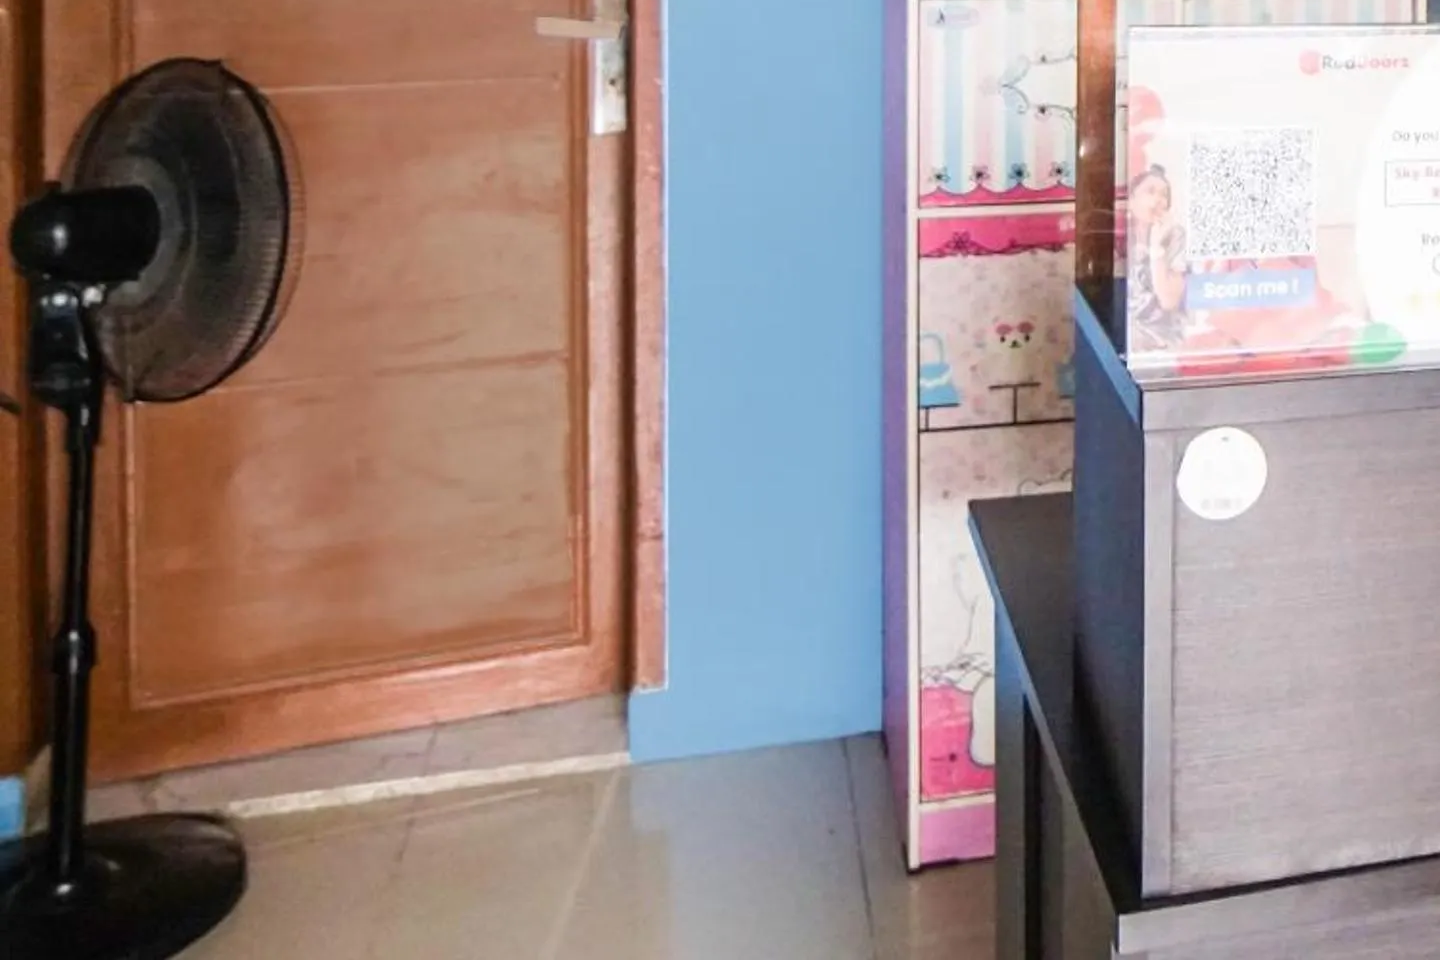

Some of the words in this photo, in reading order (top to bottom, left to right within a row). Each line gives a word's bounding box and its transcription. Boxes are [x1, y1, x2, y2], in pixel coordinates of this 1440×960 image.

[1392, 130, 1411, 142] Do
[1413, 129, 1438, 144] you
[1203, 281, 1252, 299] Scan
